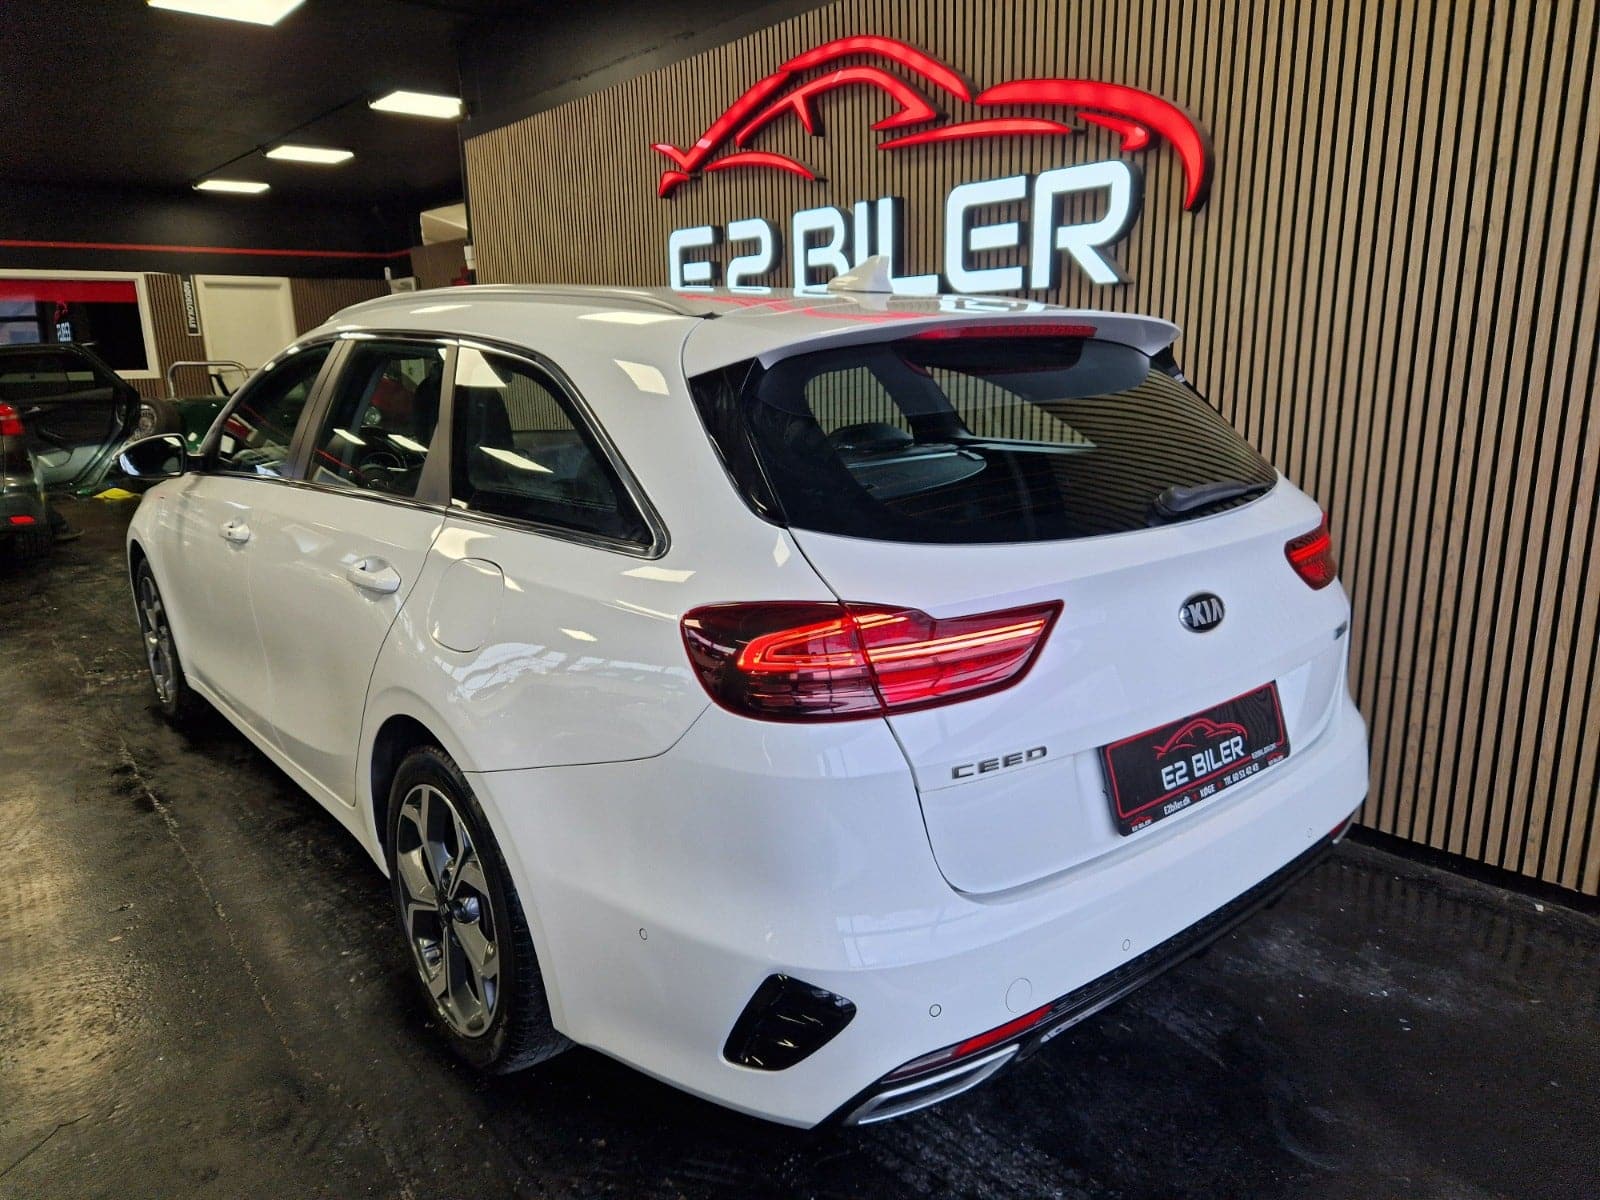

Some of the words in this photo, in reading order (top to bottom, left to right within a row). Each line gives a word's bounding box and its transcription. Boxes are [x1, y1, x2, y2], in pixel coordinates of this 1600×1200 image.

[668, 219, 775, 292] E2
[792, 159, 1133, 296] BILER
[1187, 598, 1224, 628] KIA
[951, 745, 1048, 779] CEED
[1161, 760, 1189, 790] E2
[1191, 735, 1245, 778] BILER
